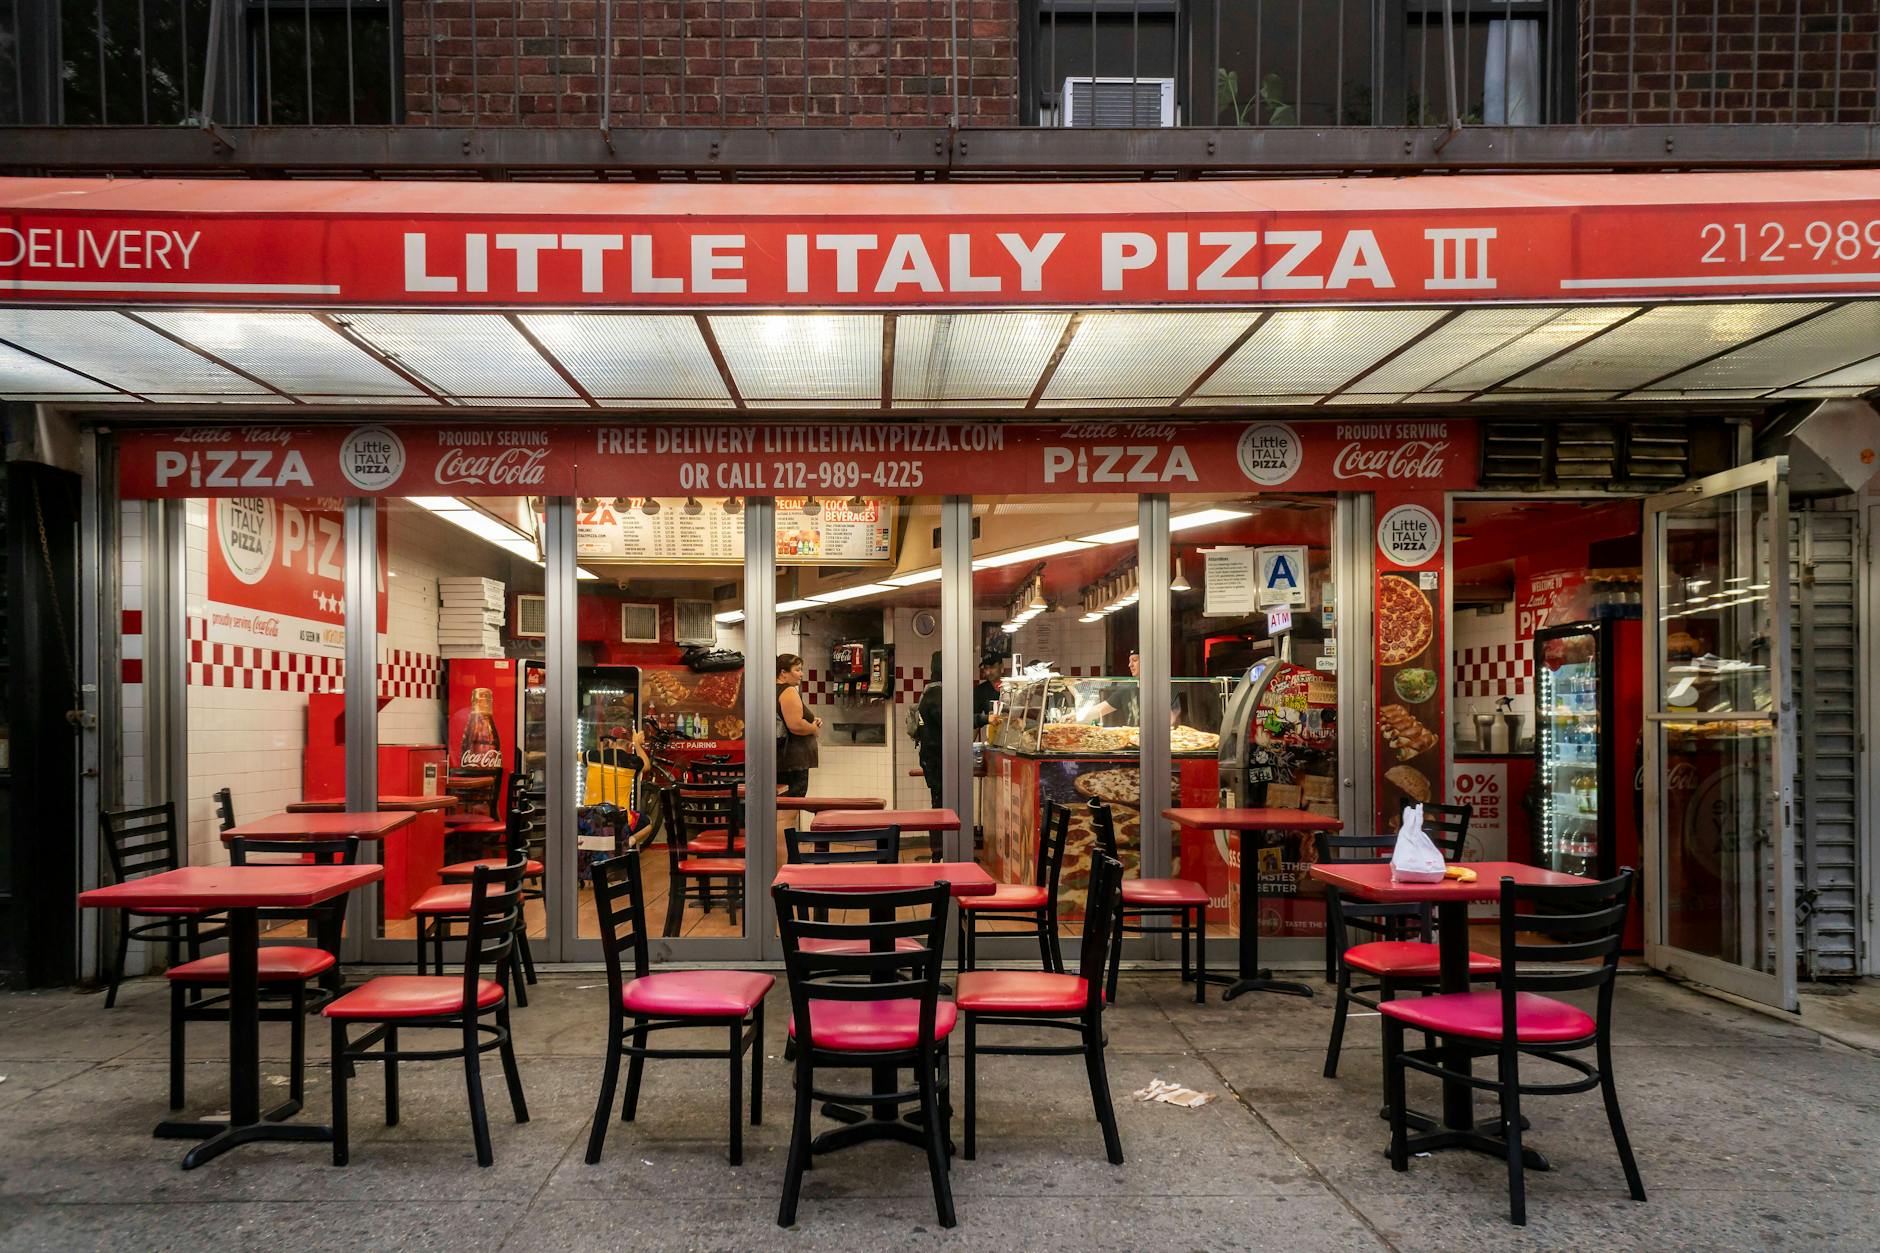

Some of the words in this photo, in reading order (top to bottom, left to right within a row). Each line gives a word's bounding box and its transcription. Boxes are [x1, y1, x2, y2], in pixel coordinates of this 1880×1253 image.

[0, 228, 201, 269] DELIVERY
[1701, 220, 1880, 263] 212-989
[404, 233, 747, 293] LITTLE
[786, 233, 1066, 293] ITALY
[1101, 229, 1396, 291] PIZZA
[1424, 227, 1498, 290] III
[174, 428, 232, 443] Little
[242, 427, 293, 446] Italy
[438, 431, 493, 446] PROUDLY
[497, 431, 549, 446] SERVING
[597, 428, 648, 454] FREE
[655, 427, 756, 454] DELIVERY
[764, 424, 1004, 453] LITTLEITALYPIZZA.COM
[1060, 424, 1118, 439] Little
[1126, 424, 1176, 442] Italy
[1336, 425, 1392, 440] PROUDLY
[1396, 423, 1448, 439] SERVING
[354, 442, 390, 453] Little
[1252, 437, 1288, 449] Little
[354, 454, 390, 465] ITALY
[1252, 449, 1288, 459] ITALY
[1333, 441, 1450, 480] Coca-Cola
[156, 450, 314, 487] PIZZA
[354, 465, 390, 474] PIZZA
[434, 448, 552, 485] Coca-Cola
[1043, 446, 1199, 483] PIZZA
[1252, 460, 1288, 469] PIZZA
[679, 462, 710, 490] OR
[716, 462, 766, 489] CALL
[773, 461, 924, 489] 212-989-4225
[231, 508, 264, 537] ITALY
[825, 511, 876, 522] BEVERAGES
[1392, 520, 1427, 531] Little
[231, 531, 264, 555] PIZZA
[1392, 532, 1427, 542] ITALY
[1392, 543, 1427, 551] PIZZA
[1267, 555, 1297, 589] A
[1271, 612, 1290, 628] ATM
[1520, 608, 1552, 635] PIZ
[686, 741, 717, 749] PAIRING
[461, 749, 502, 768] Coca-Cola
